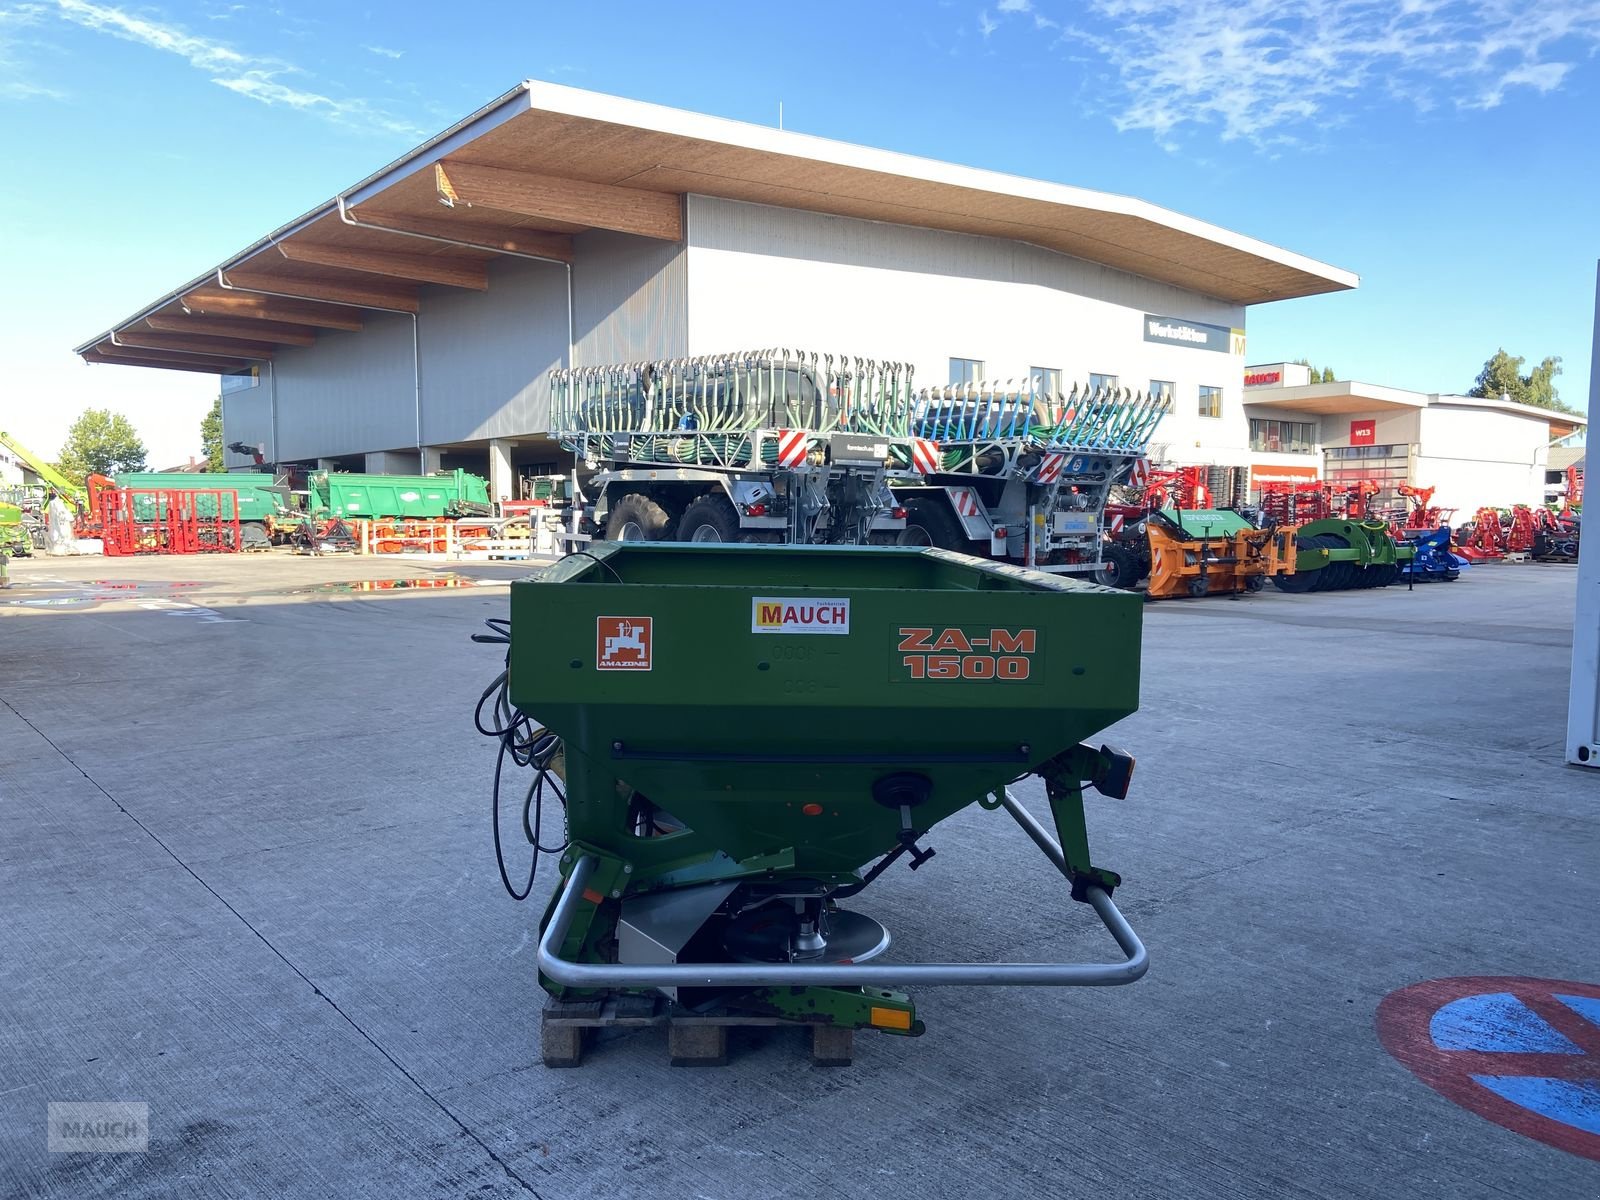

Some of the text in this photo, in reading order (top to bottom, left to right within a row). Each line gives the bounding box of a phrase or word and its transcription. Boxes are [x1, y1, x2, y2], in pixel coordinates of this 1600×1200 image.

[1355, 429, 1371, 437] W13
[761, 605, 846, 625] MAUCH
[898, 627, 1036, 653] ZA-M
[599, 660, 649, 668] AMAZONE
[903, 655, 1030, 680] 1500
